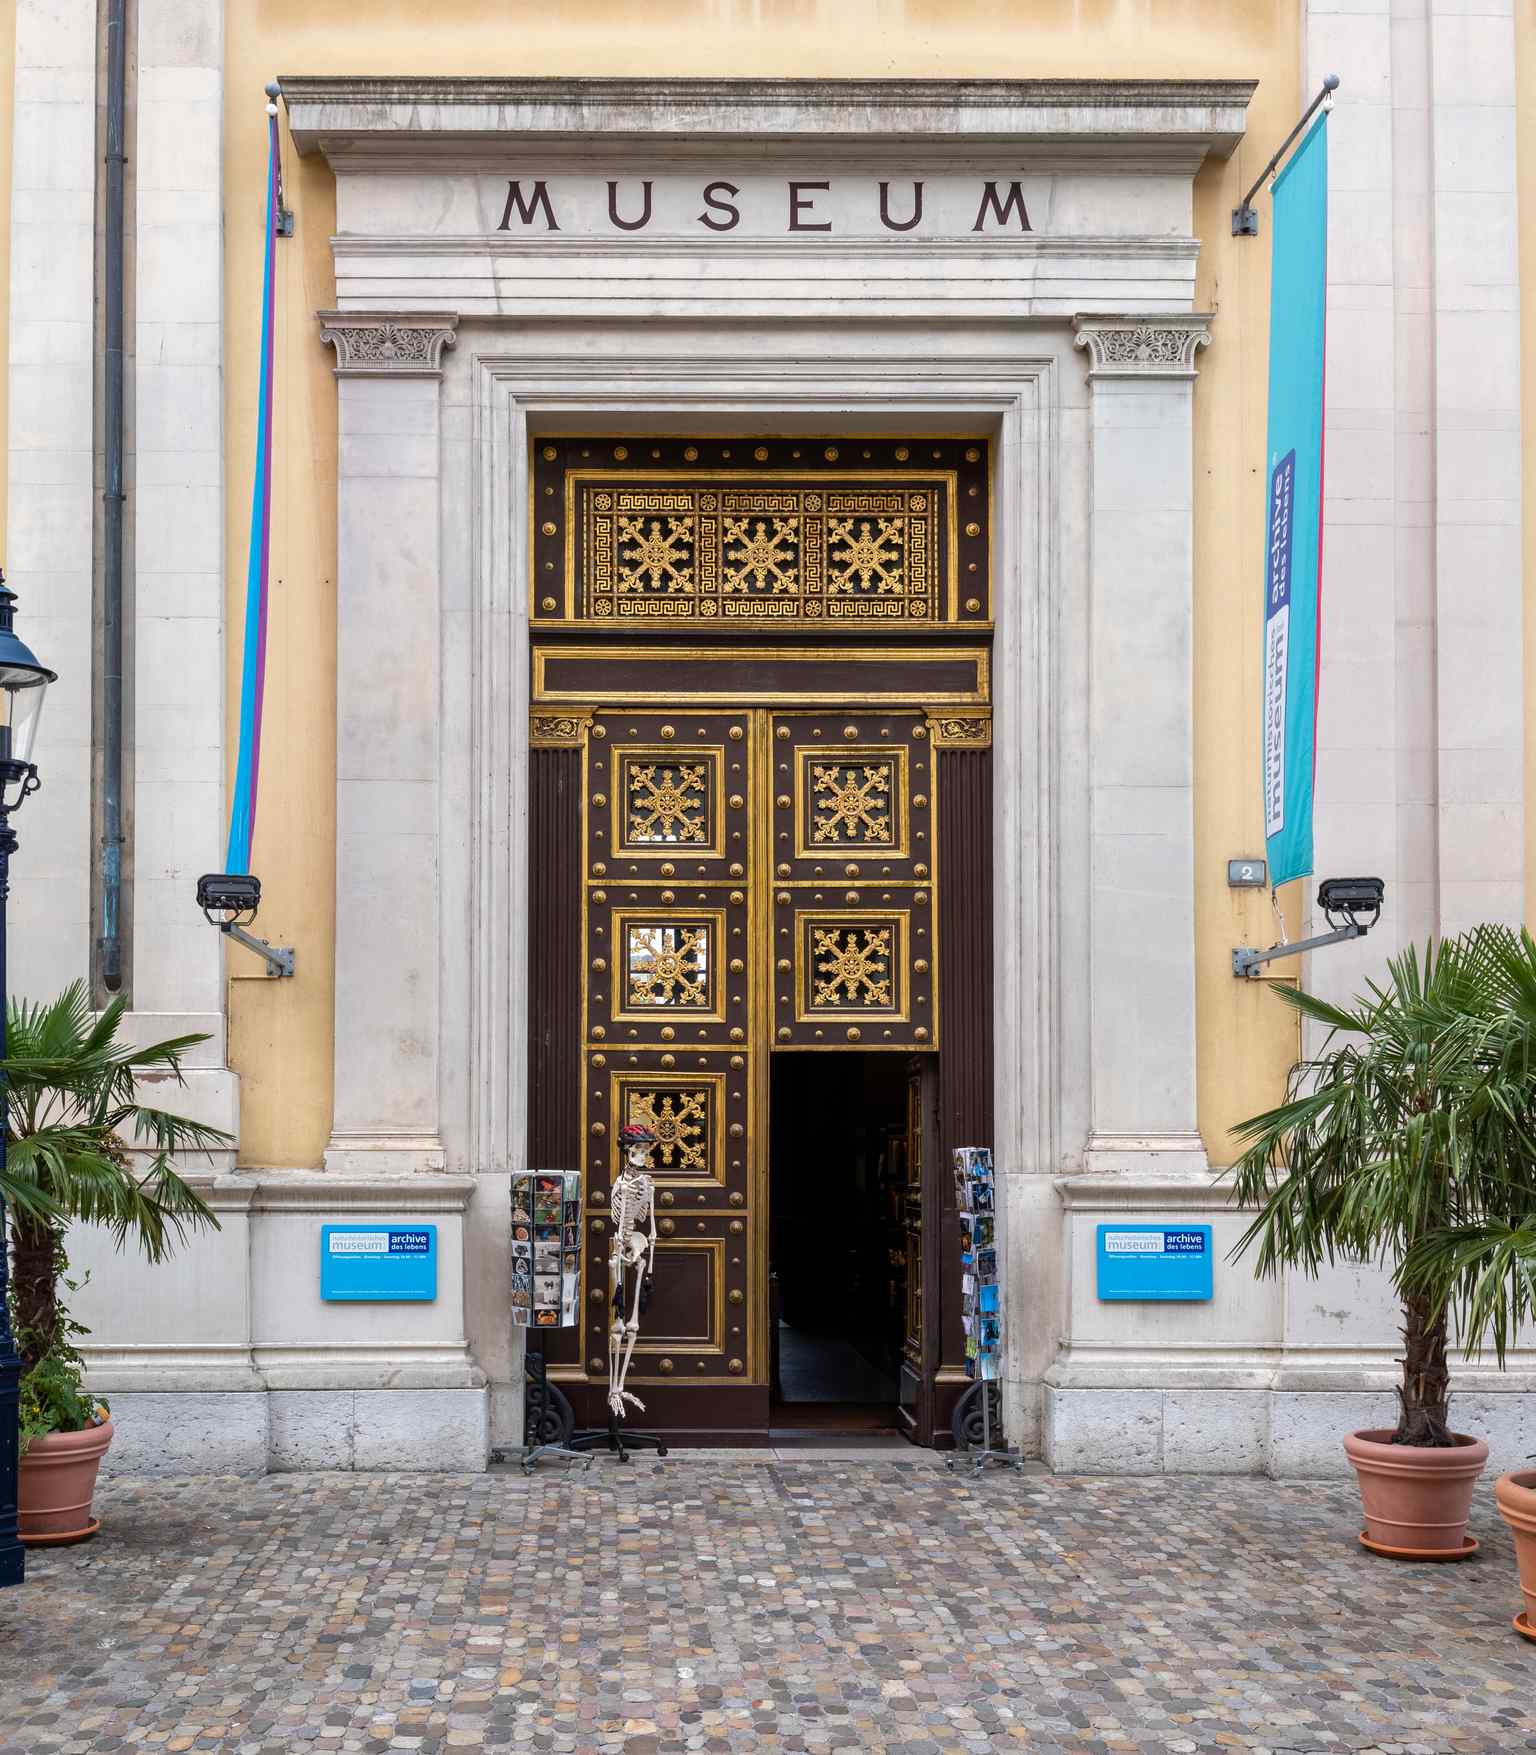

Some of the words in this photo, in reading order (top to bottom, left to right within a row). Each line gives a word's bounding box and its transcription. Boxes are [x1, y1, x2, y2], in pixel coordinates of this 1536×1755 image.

[497, 181, 1033, 232] MUSEUM
[1280, 464, 1291, 549] lebens
[1272, 474, 1283, 604] archive
[1279, 553, 1287, 598] des
[1272, 631, 1284, 821] museum
[1241, 865, 1253, 880] 2
[332, 1240, 382, 1250] museum
[391, 1234, 427, 1243] archive
[1108, 1240, 1158, 1250] museum
[1166, 1234, 1202, 1243] archive
